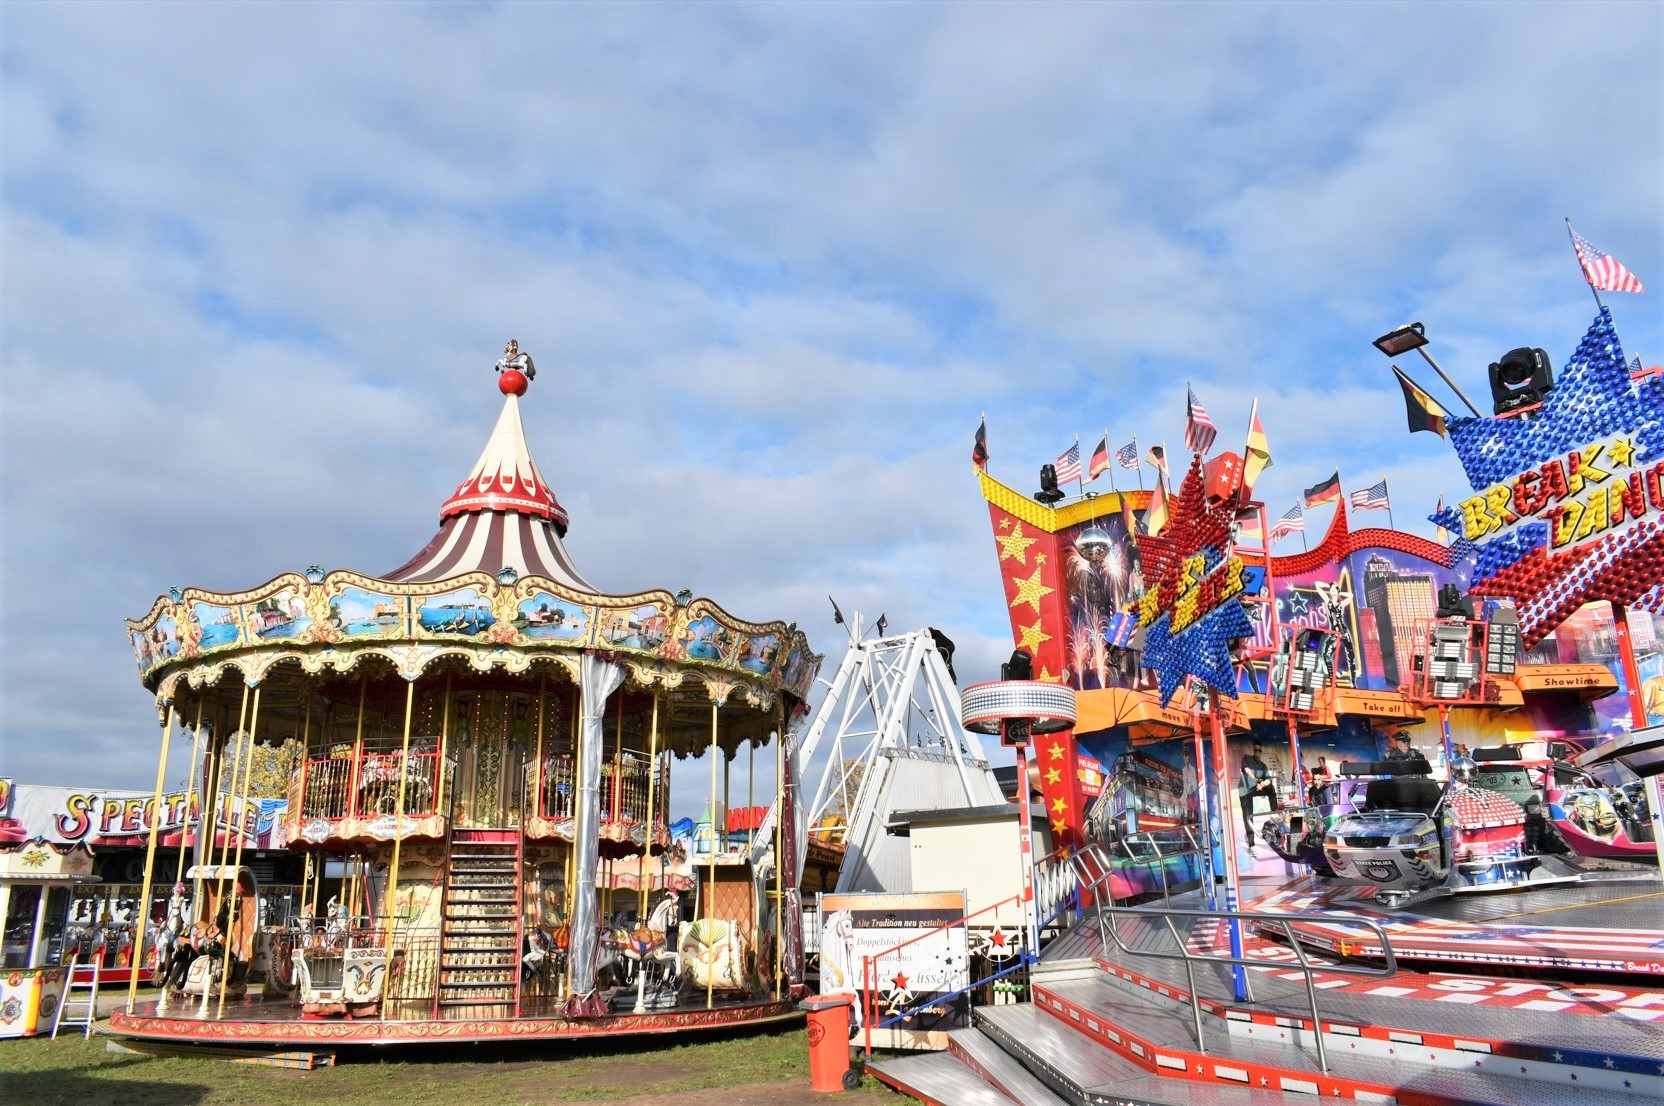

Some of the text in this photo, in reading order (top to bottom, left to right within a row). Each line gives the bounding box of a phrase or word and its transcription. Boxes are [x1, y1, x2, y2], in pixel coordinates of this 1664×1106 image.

[1460, 445, 1611, 541] BREAK
[1544, 677, 1600, 686] Showtime
[1363, 702, 1385, 712] Take
[1161, 712, 1181, 722] move
[1078, 758, 1099, 771] MELROSE
[52, 791, 257, 840] SPECTALE
[856, 919, 870, 928] Alte
[871, 918, 903, 927] Tradition
[1627, 962, 1650, 972] Break
